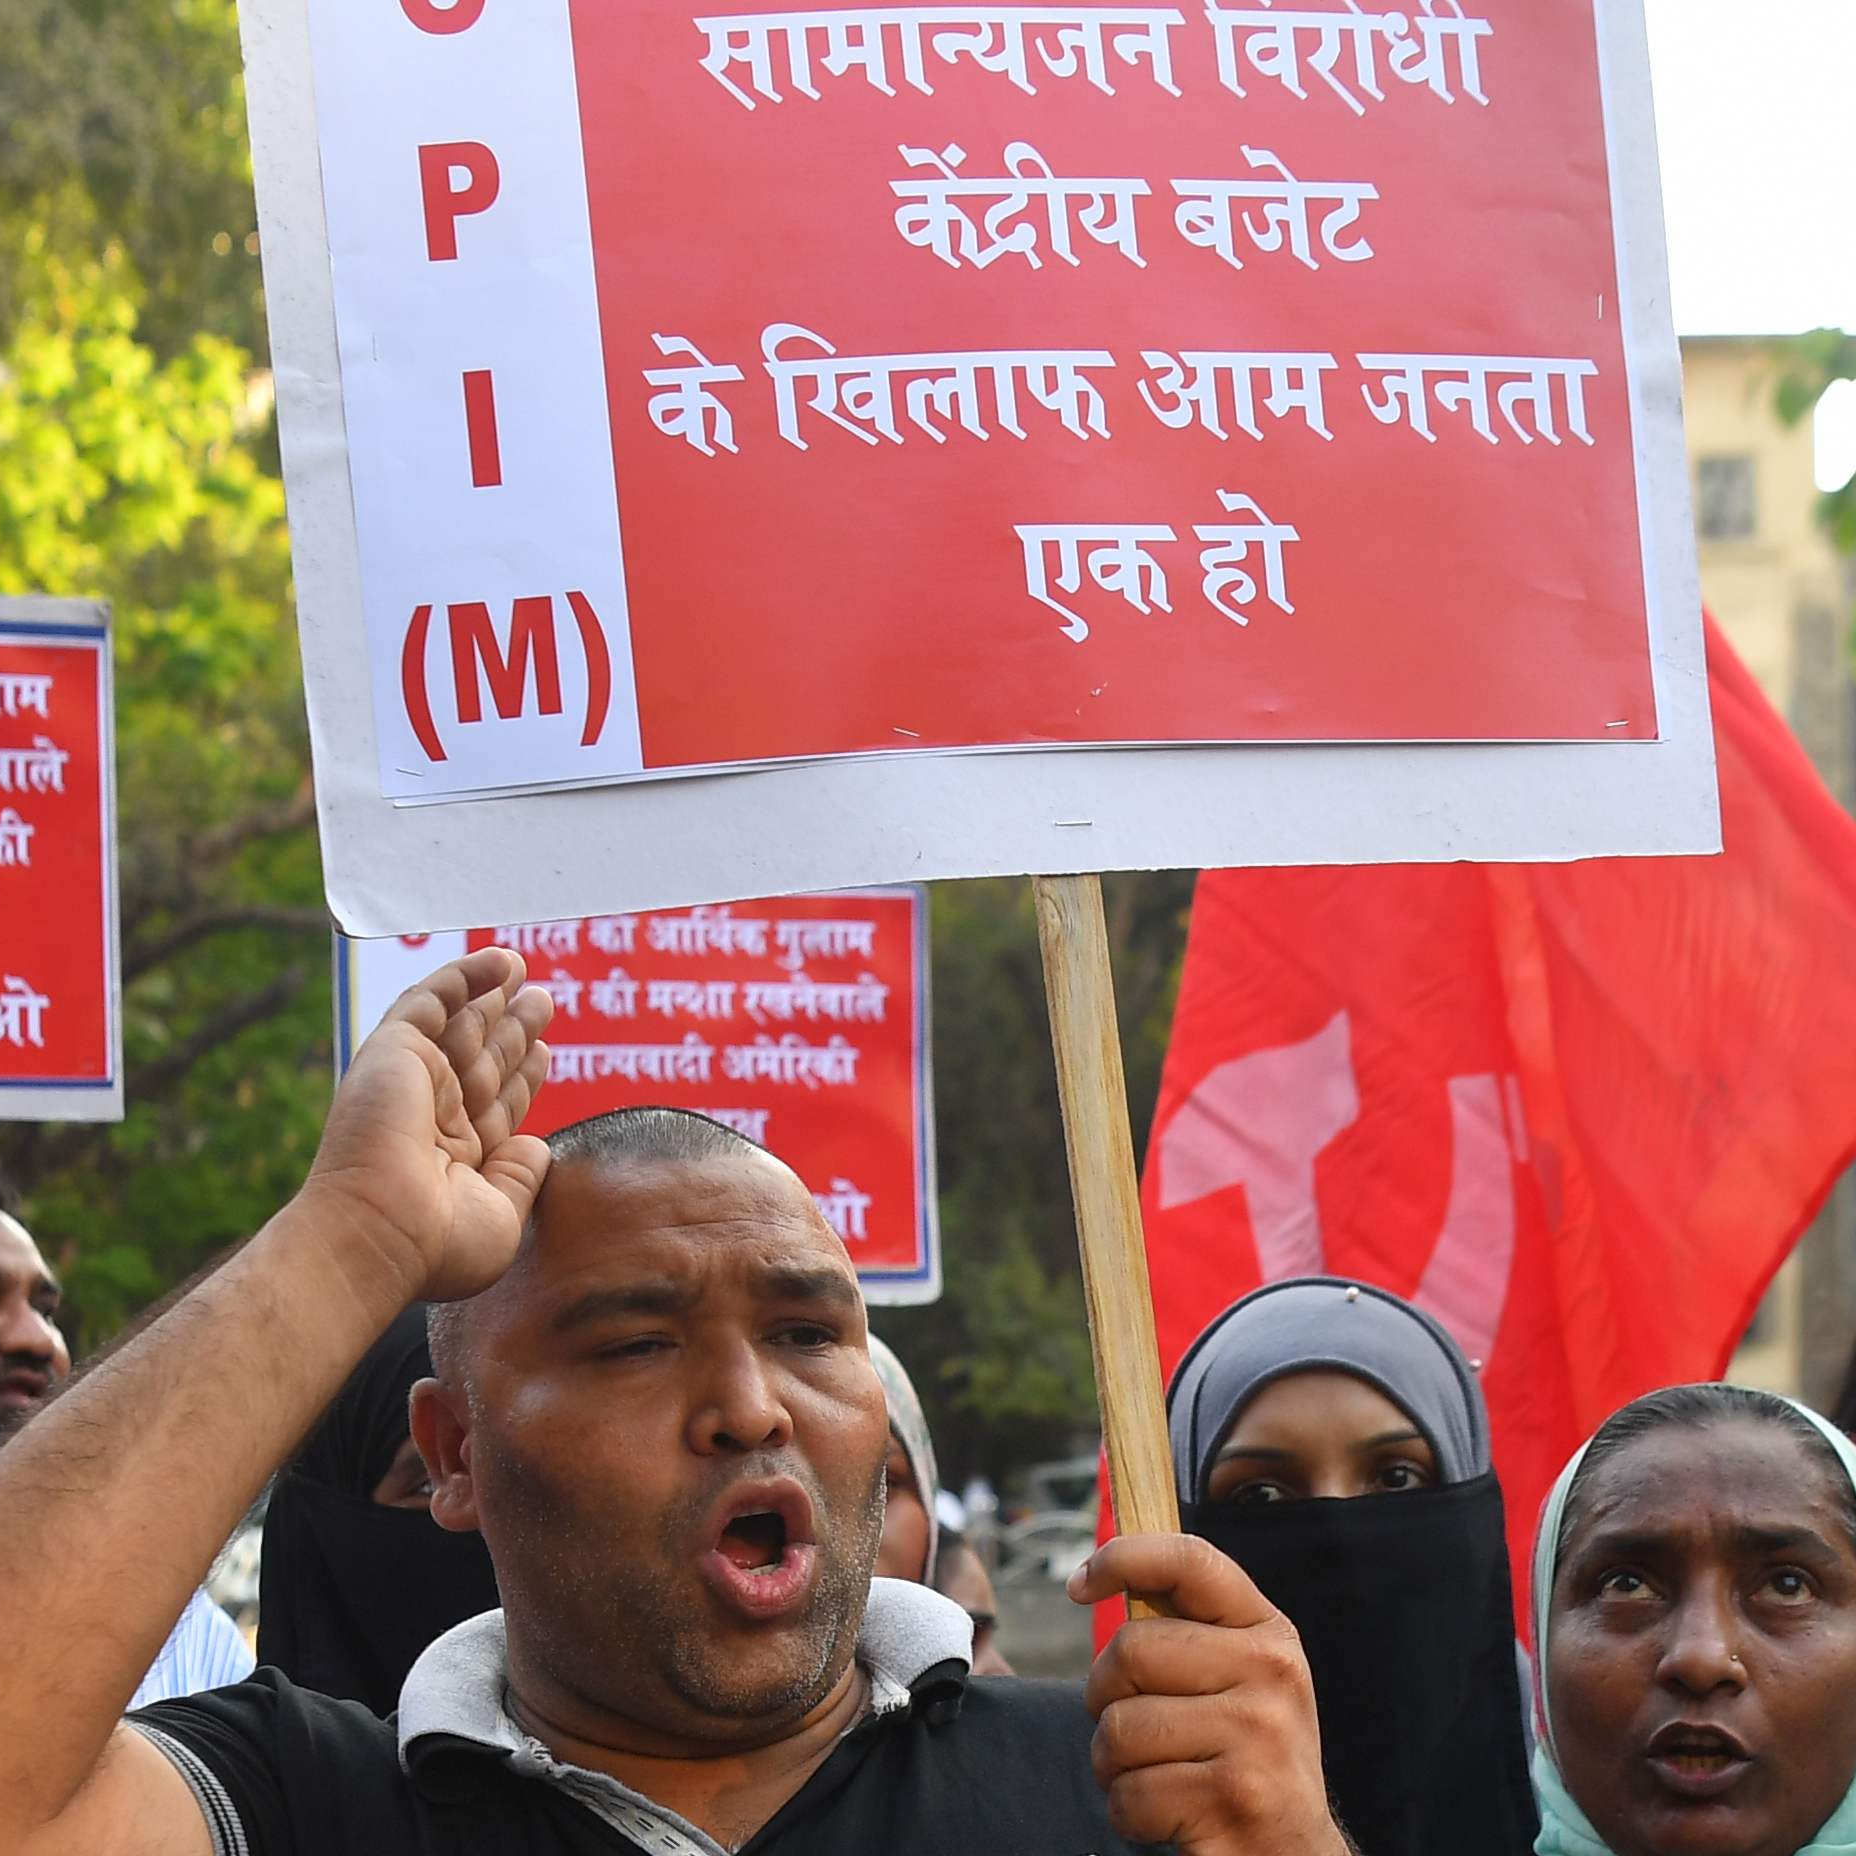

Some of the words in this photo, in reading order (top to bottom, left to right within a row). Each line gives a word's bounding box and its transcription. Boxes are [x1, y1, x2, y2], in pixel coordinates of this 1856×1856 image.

[691, 5, 1187, 112] सामान्यजन
[420, 143, 499, 260] P
[888, 138, 1153, 272] केंद्रीय
[1170, 144, 1380, 272] बजेट
[464, 371, 501, 487] I
[642, 332, 745, 458] के
[761, 322, 1118, 451] खिलाफ
[1136, 348, 1342, 442] आम
[1356, 352, 1600, 447] जनता
[1013, 523, 1181, 643] एक
[1191, 488, 1301, 627] हो
[403, 592, 610, 761] (M)
[775, 918, 877, 972] गुलाम
